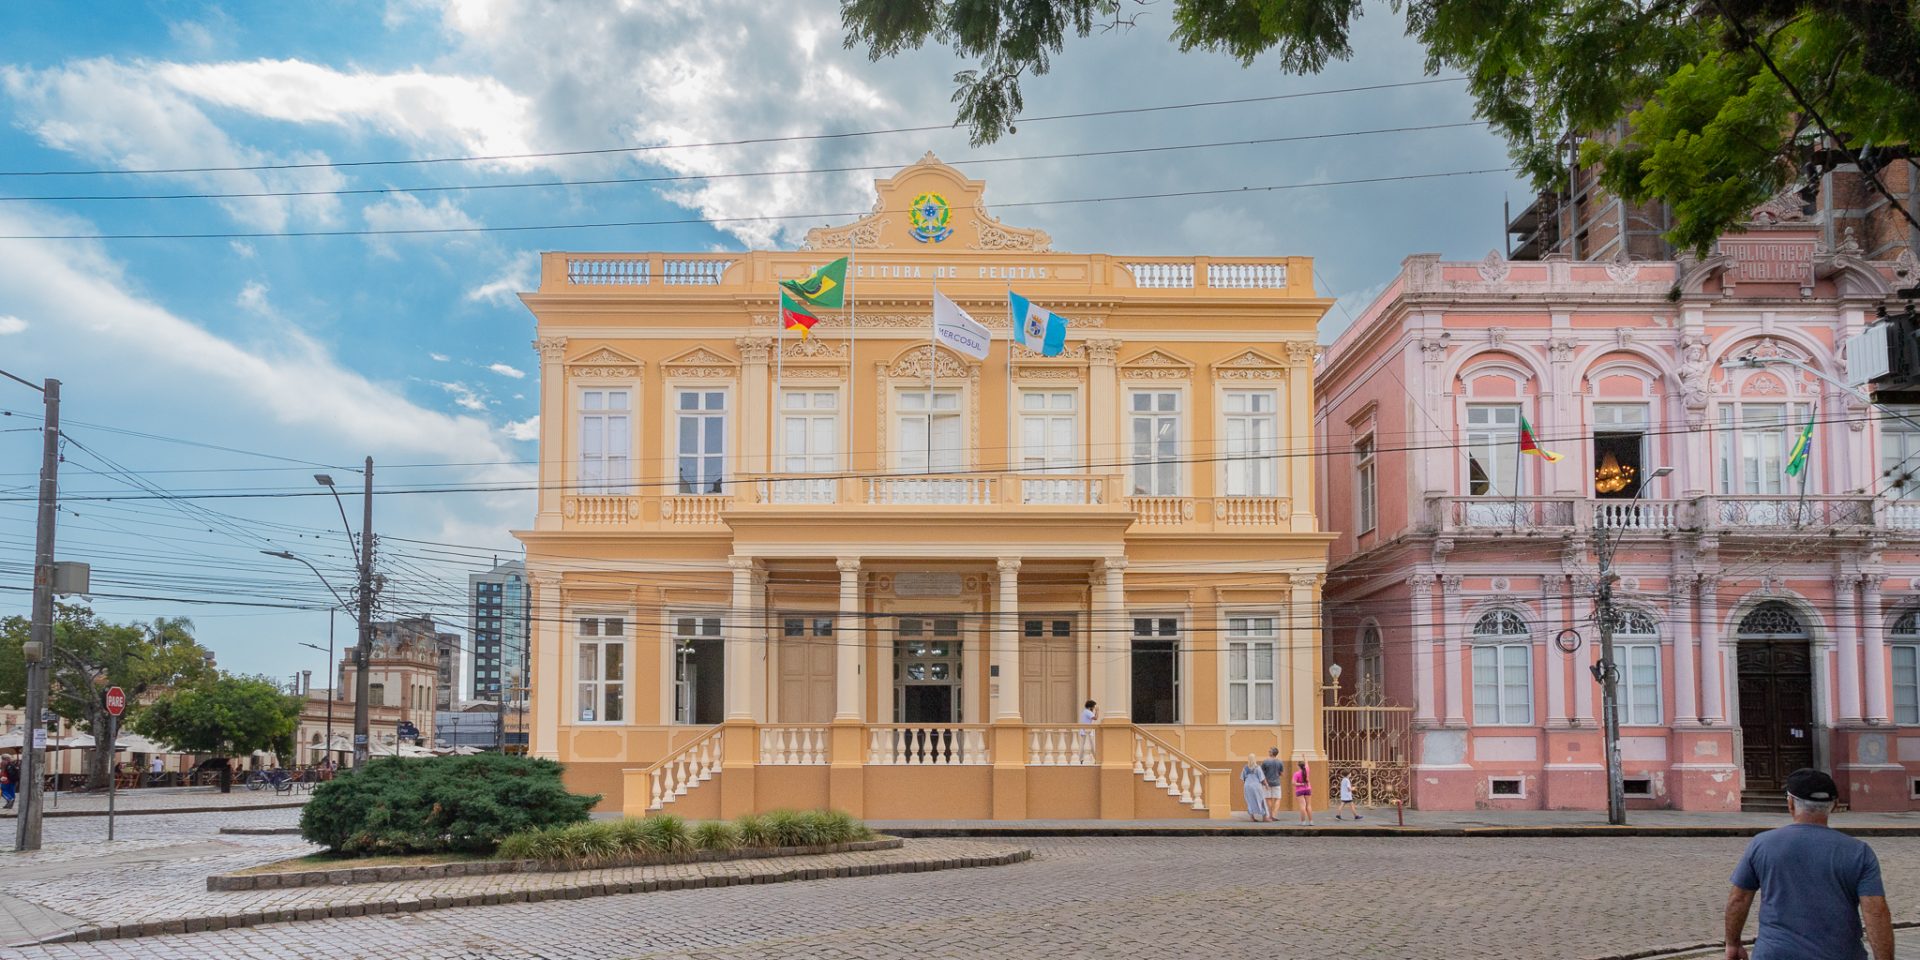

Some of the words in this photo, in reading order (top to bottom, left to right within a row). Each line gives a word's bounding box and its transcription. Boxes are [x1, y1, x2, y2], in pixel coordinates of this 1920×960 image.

[1726, 244, 1809, 261] BIBLIOTHECA
[811, 265, 921, 278] PFEITURA
[938, 266, 957, 278] DE
[979, 266, 1046, 279] PELOTAS
[1740, 262, 1797, 279] PUBLICA
[938, 327, 982, 352] MERCOSUL
[108, 695, 124, 707] PARE
